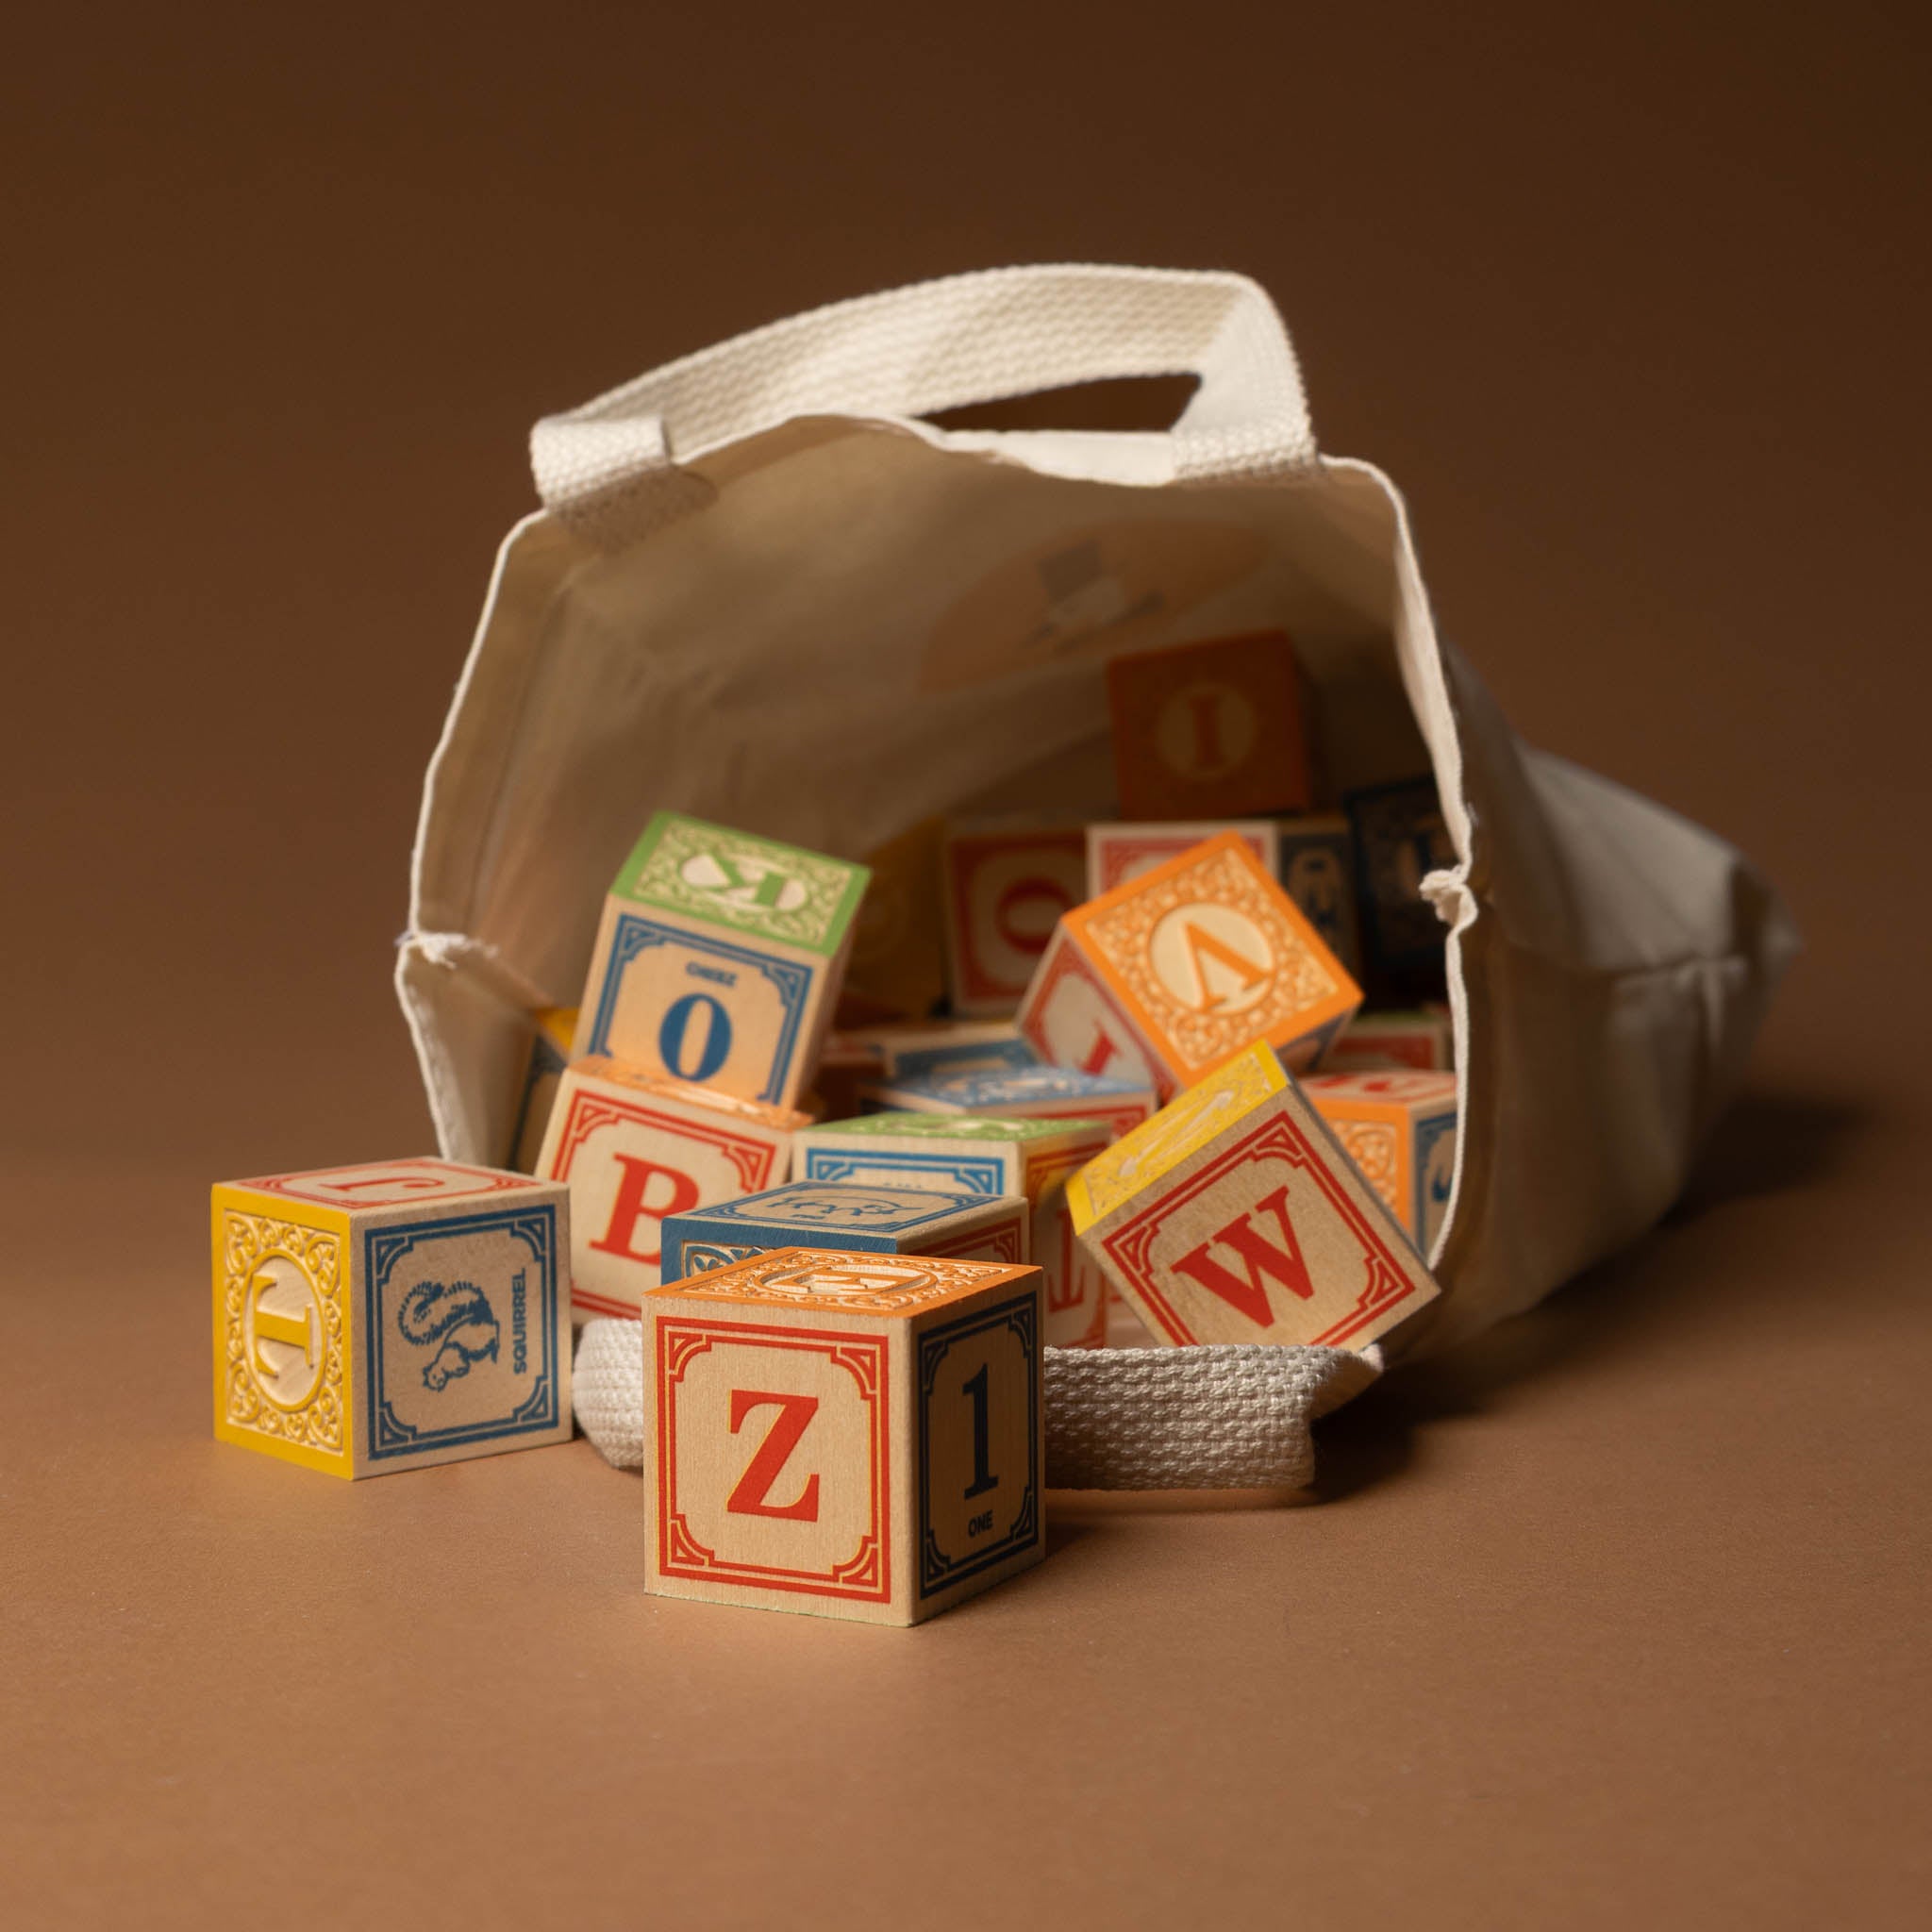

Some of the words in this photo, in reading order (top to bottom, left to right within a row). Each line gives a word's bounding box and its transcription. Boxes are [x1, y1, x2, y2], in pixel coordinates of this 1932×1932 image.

[589, 1153, 700, 1267] B
[1170, 1185, 1314, 1328] W
[253, 1274, 312, 1378] T
[511, 1269, 527, 1375] SQUIRREL
[726, 1389, 820, 1523] Z
[961, 1362, 999, 1501] 1
[967, 1511, 993, 1539] ONE
